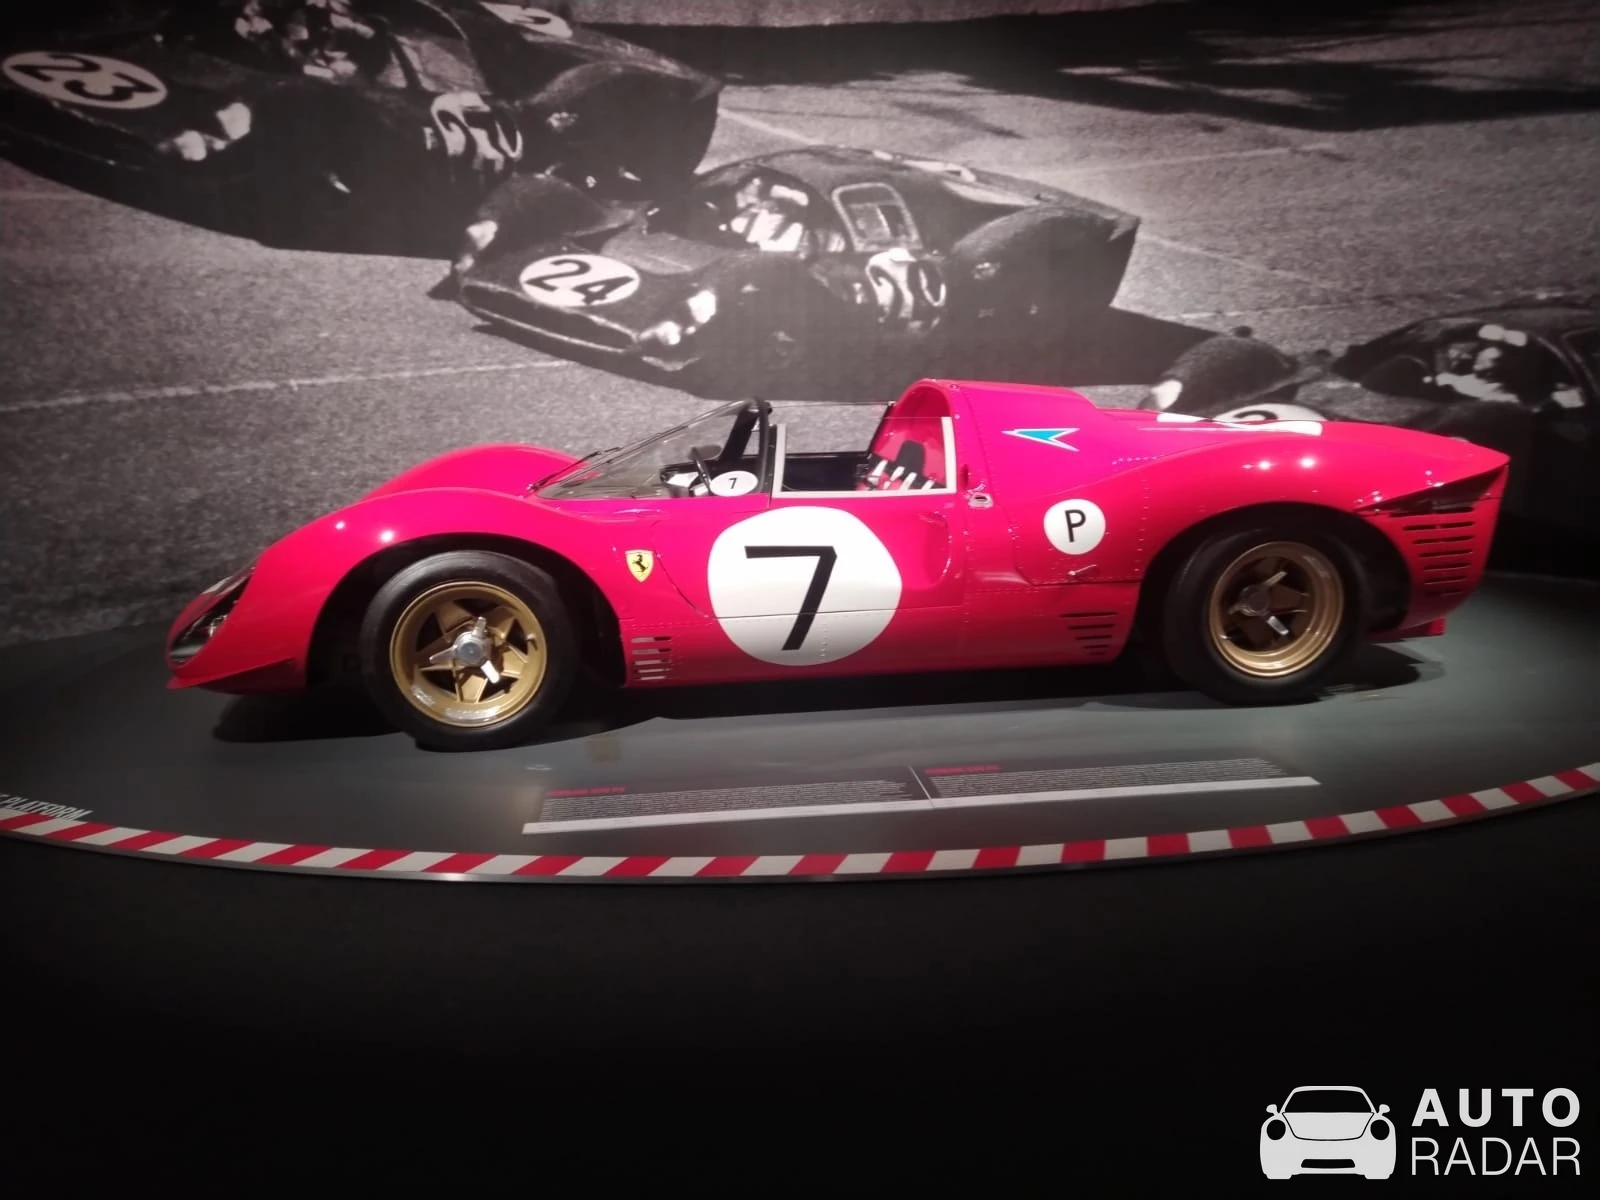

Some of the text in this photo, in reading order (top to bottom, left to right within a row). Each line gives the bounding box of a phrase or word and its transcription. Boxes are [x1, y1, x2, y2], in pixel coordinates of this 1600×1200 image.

[10, 54, 160, 102] 23
[524, 258, 635, 306] 24
[729, 477, 738, 490] 7
[1064, 508, 1087, 543] P
[744, 545, 837, 651] 7
